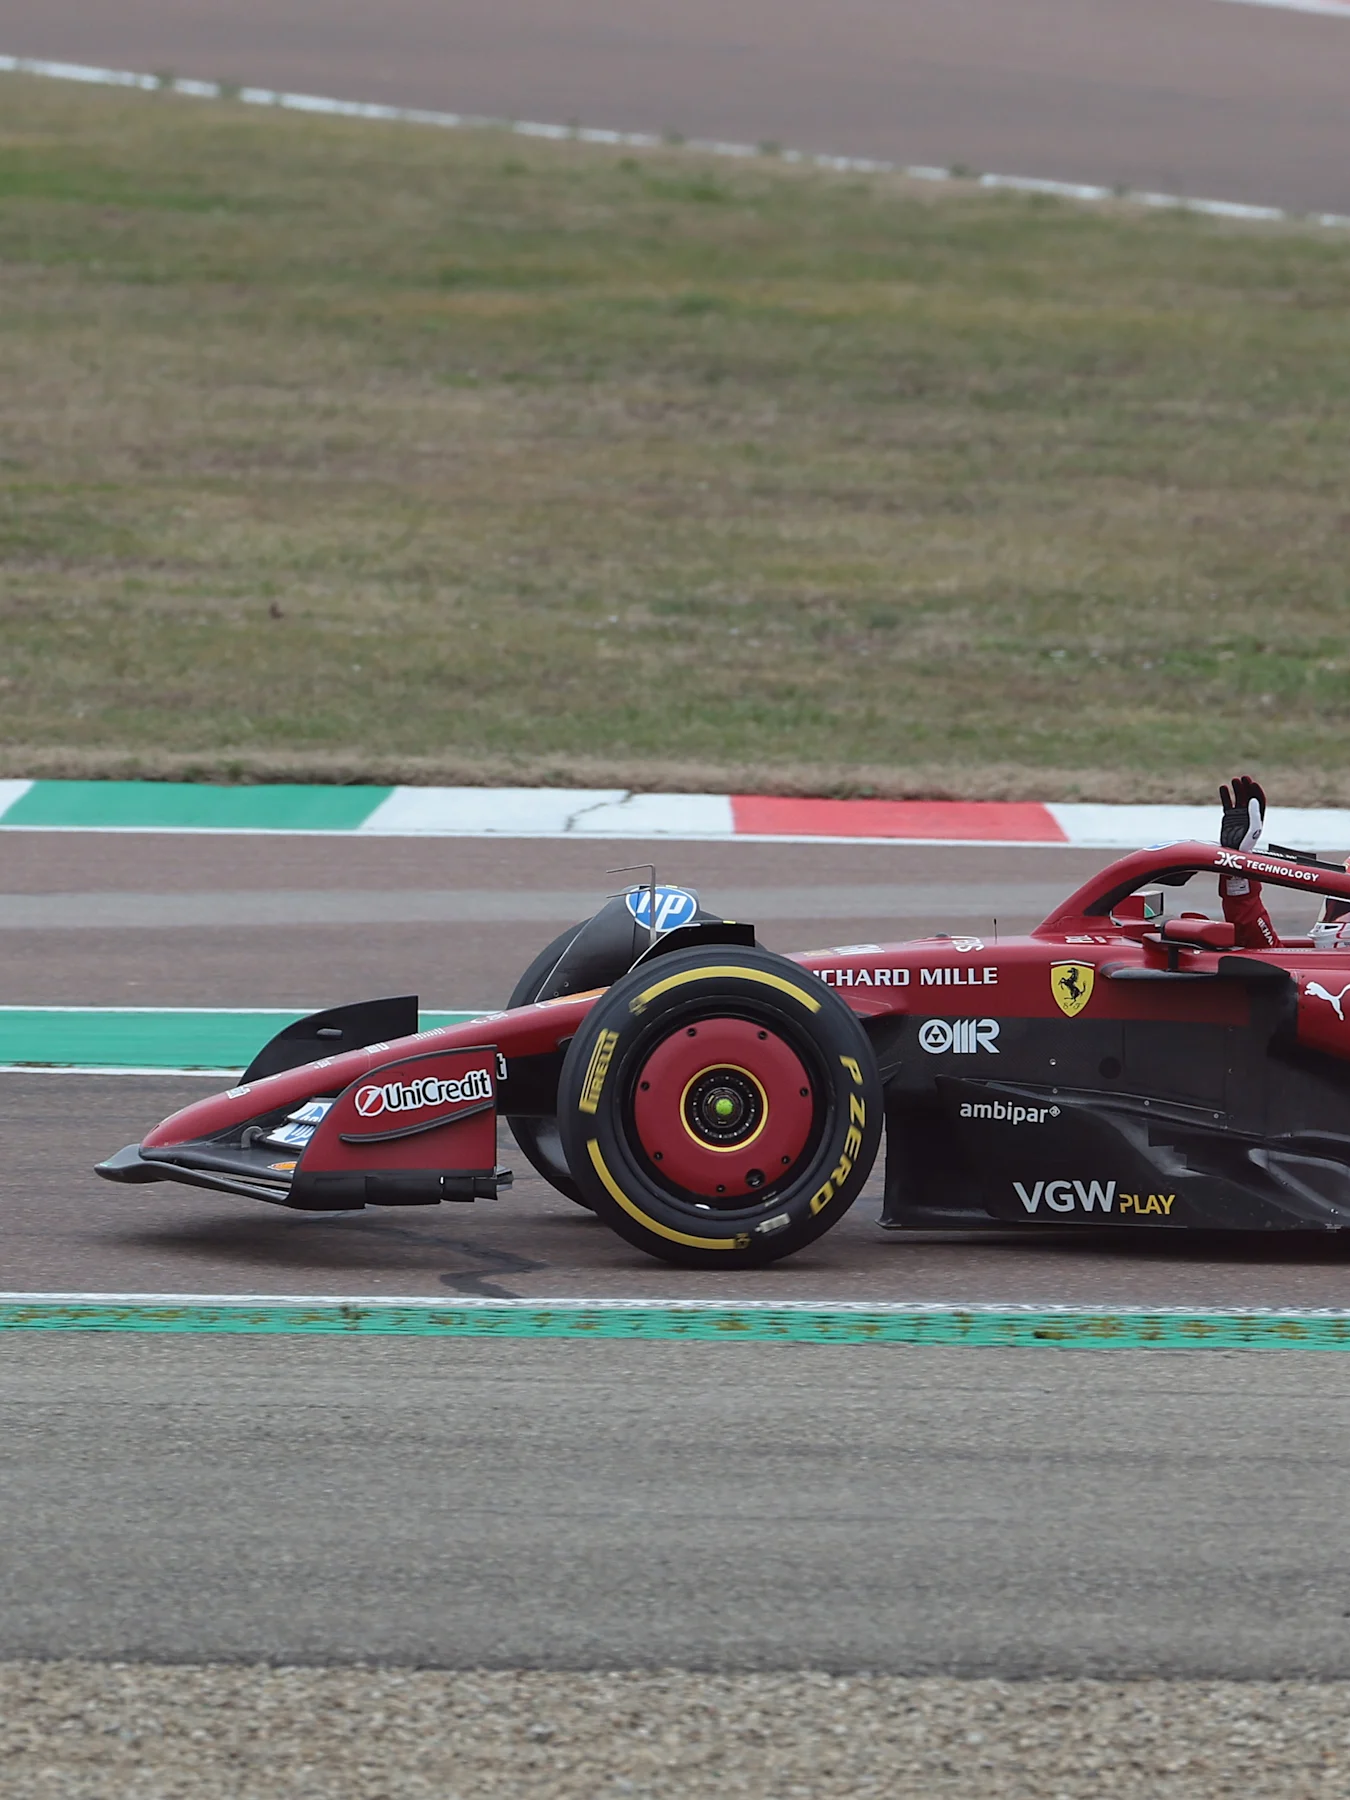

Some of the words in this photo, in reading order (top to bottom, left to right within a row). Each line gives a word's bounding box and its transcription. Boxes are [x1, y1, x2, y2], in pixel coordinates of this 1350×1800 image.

[1246, 859, 1319, 882] TECHNOLOGY
[920, 967, 998, 986] MILLE
[839, 1054, 865, 1086] P
[385, 1070, 491, 1109] UniCredit
[959, 1101, 1049, 1125] ambipar
[808, 1092, 867, 1218] ZERO
[1012, 1180, 1116, 1214] VGW
[1118, 1194, 1176, 1215] PLAY
